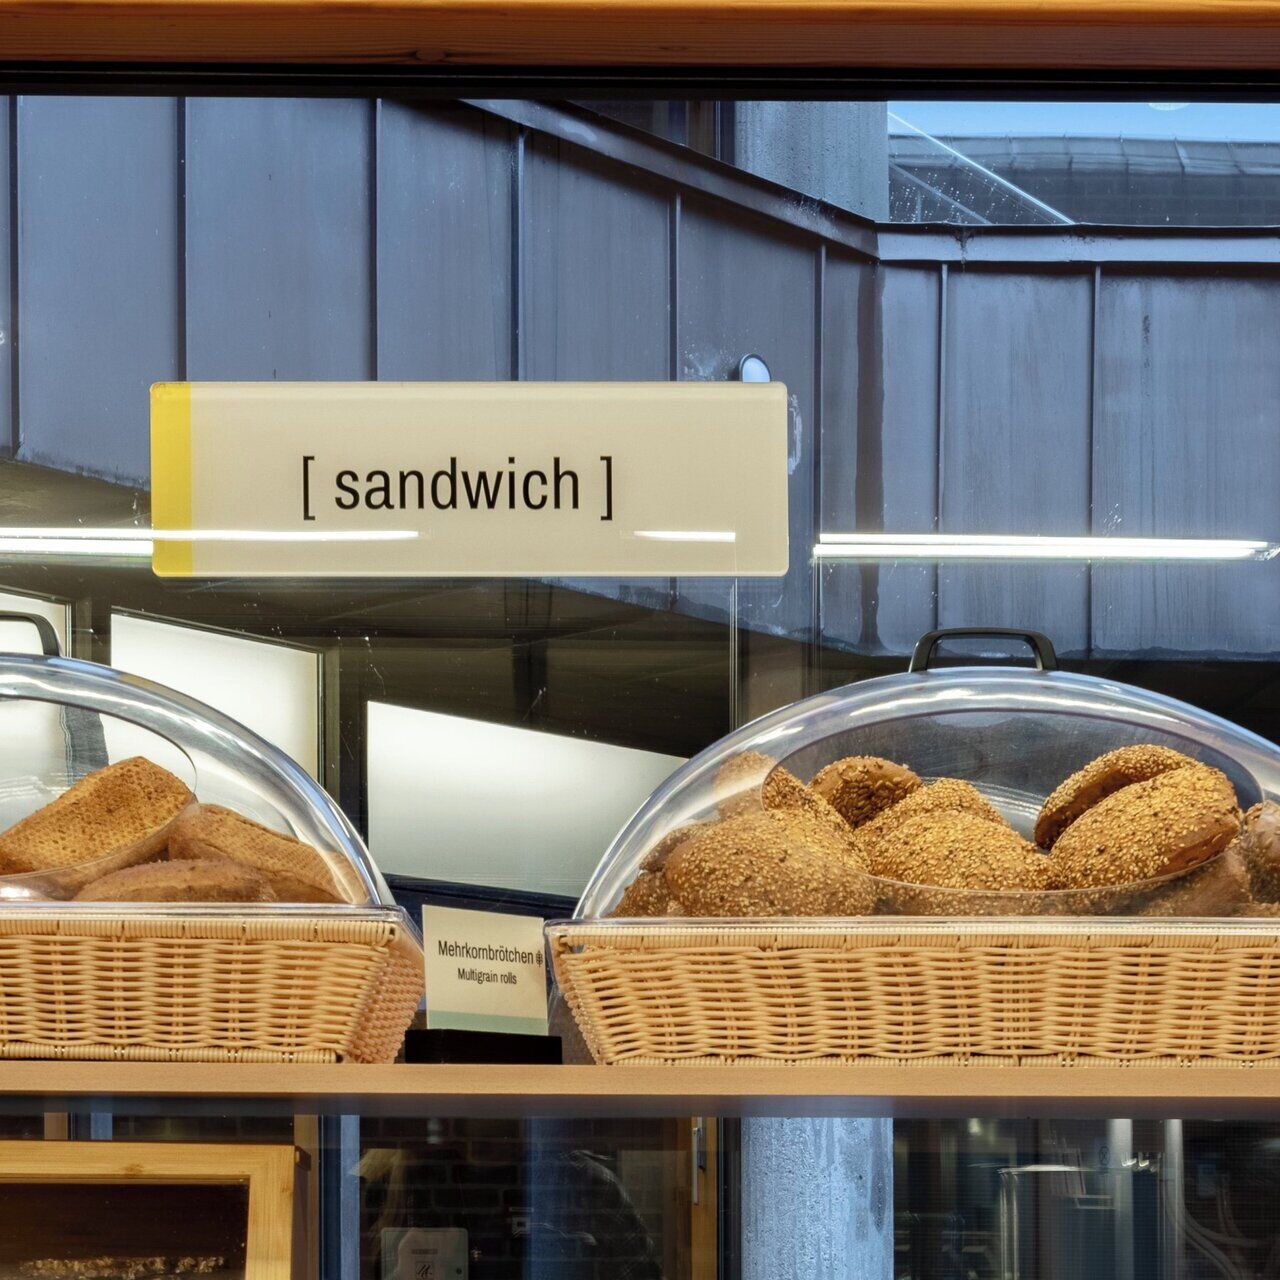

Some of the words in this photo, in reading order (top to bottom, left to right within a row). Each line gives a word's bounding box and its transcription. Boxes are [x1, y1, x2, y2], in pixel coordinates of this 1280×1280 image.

[334, 456, 580, 511] sandwich
[438, 940, 534, 965] Mehrkornbrötchen
[458, 967, 498, 985] Multigrain
[500, 972, 517, 985] rolls
